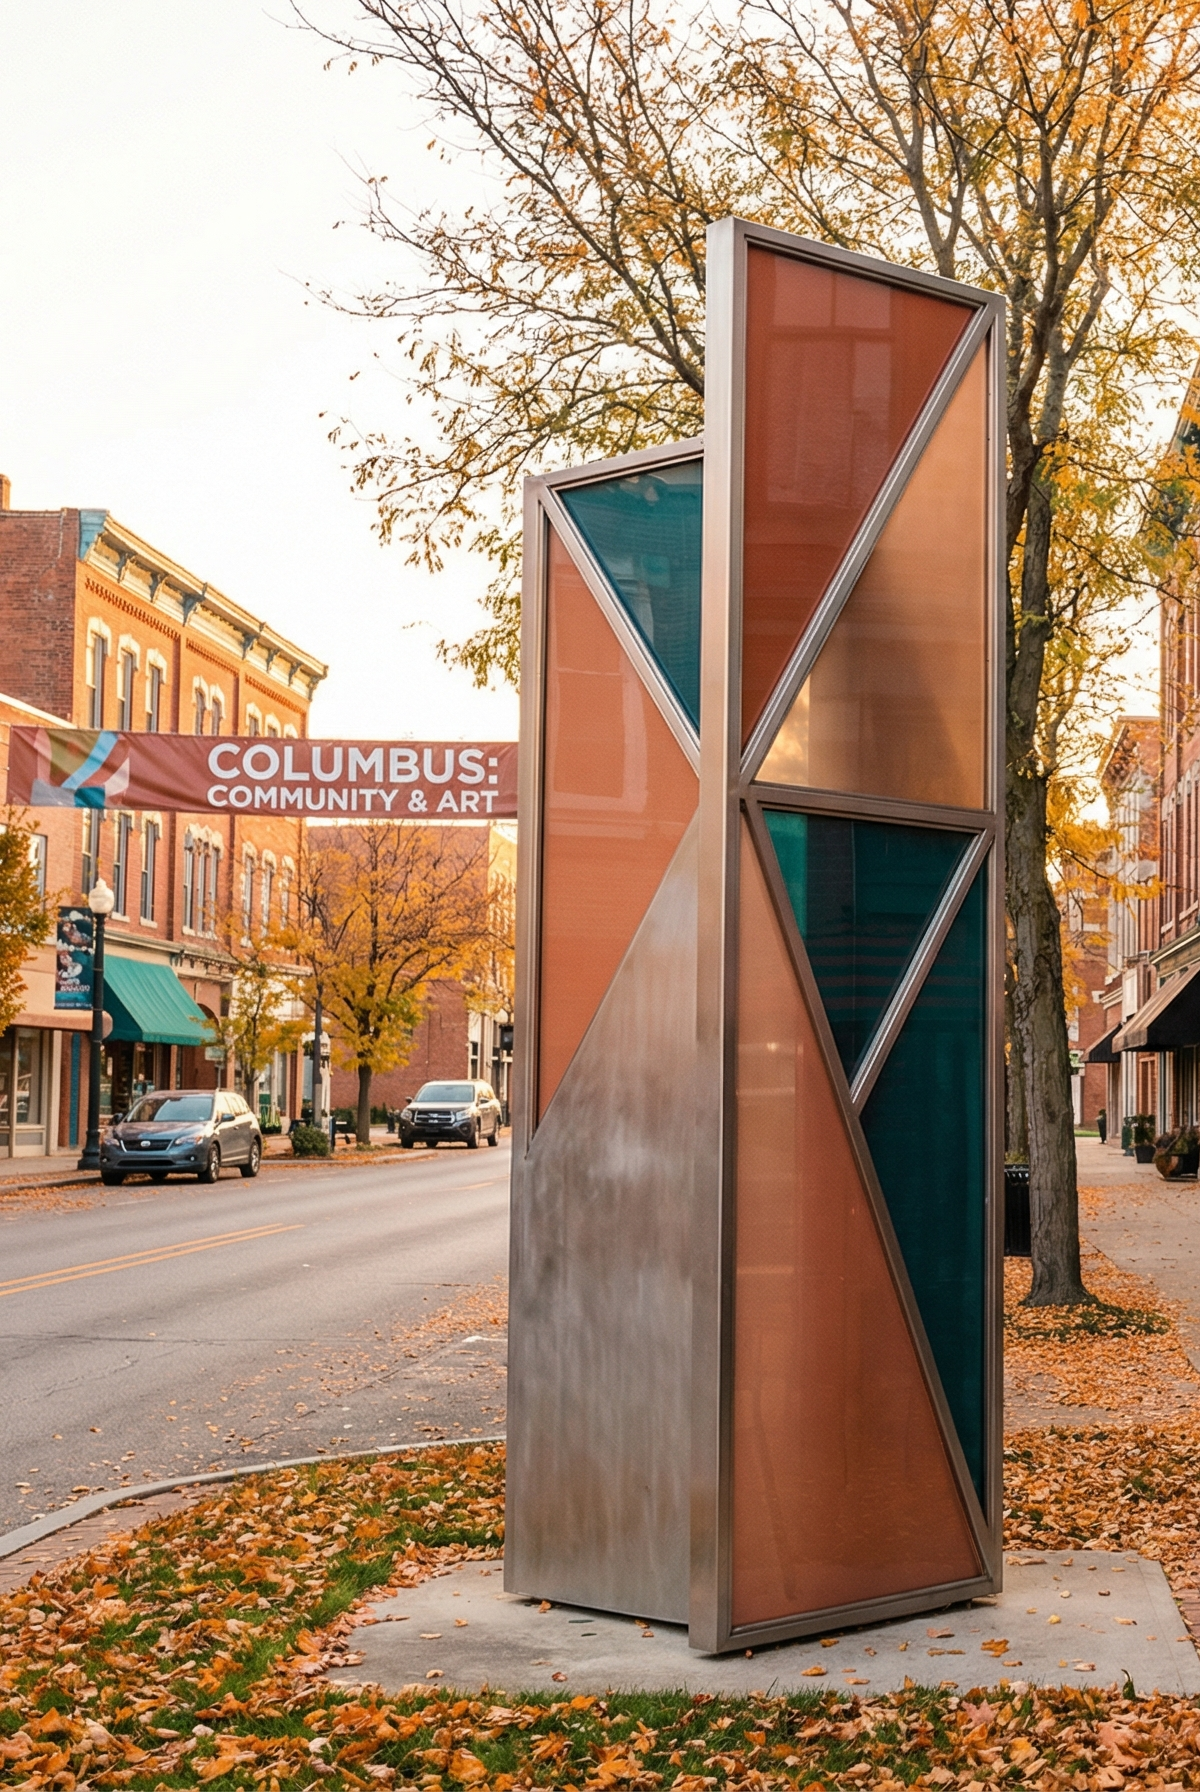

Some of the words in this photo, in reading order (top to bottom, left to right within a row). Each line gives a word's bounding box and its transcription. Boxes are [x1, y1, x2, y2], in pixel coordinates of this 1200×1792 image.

[208, 743, 498, 784] COLUMBUS:
[206, 784, 399, 812] COMMUNITY
[407, 789, 428, 813] &
[436, 790, 499, 813] ART
